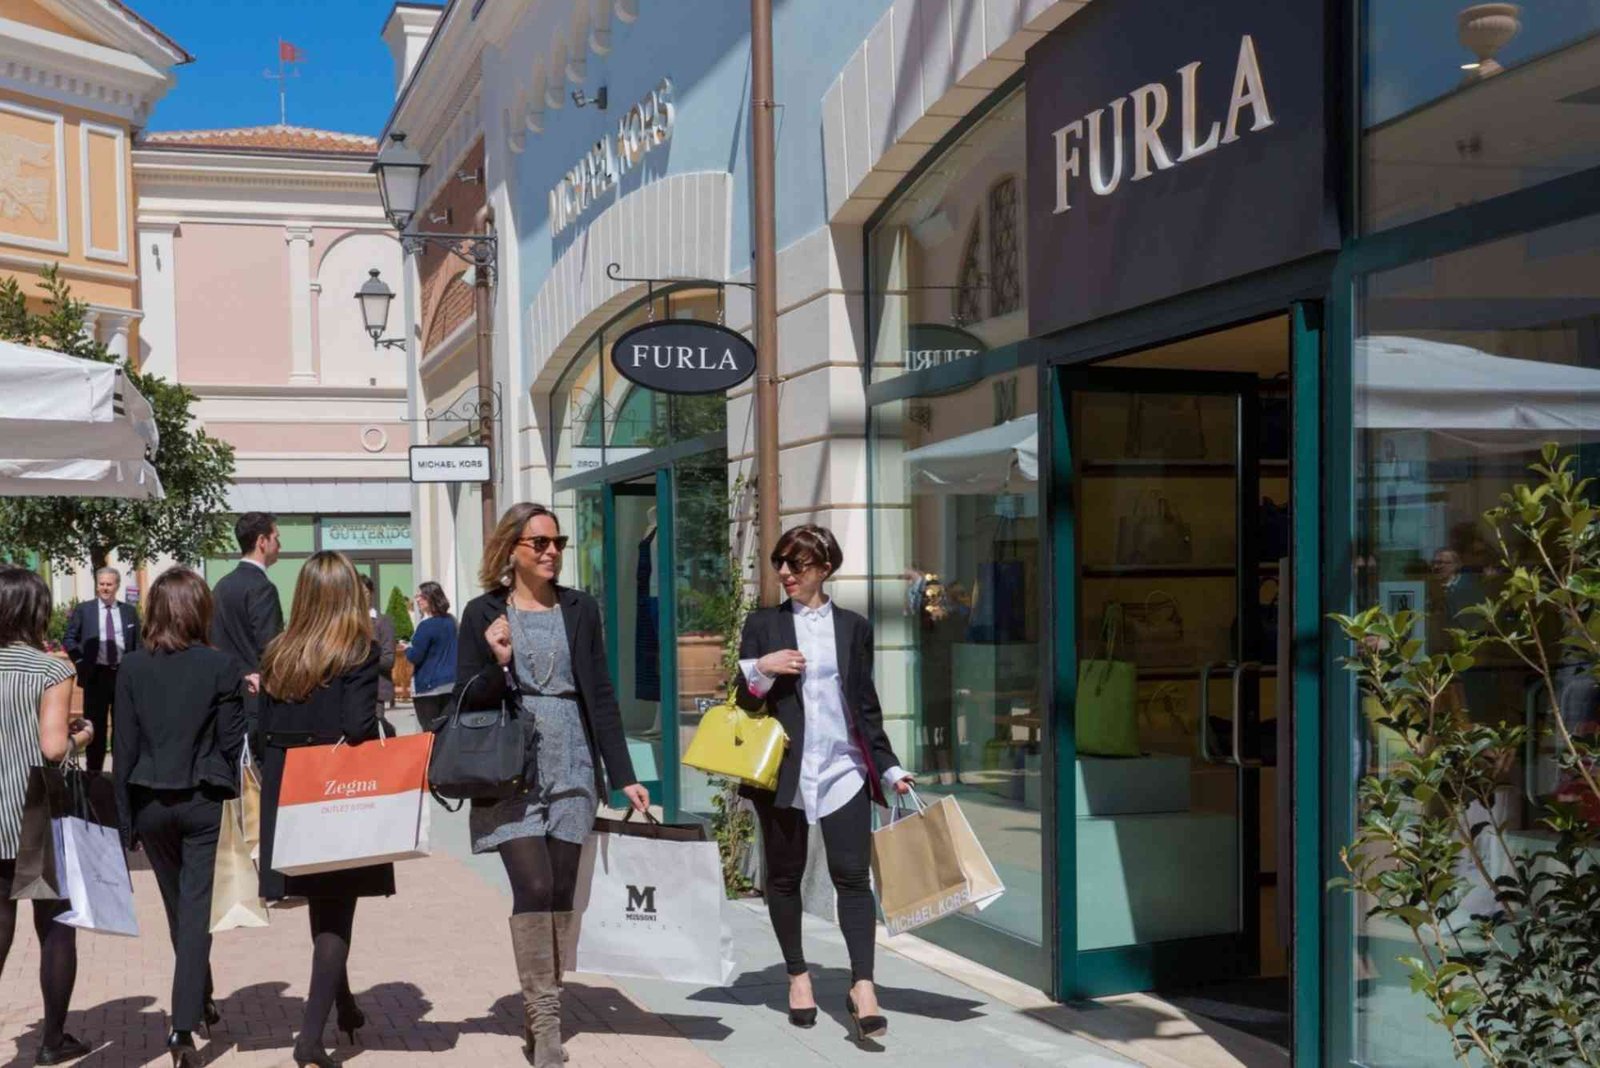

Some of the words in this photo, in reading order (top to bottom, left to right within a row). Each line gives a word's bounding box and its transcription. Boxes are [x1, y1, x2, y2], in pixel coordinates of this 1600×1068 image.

[1052, 34, 1275, 214] FURLA
[632, 345, 739, 370] FURLA
[324, 780, 377, 796] Zegna
[626, 885, 657, 913] M
